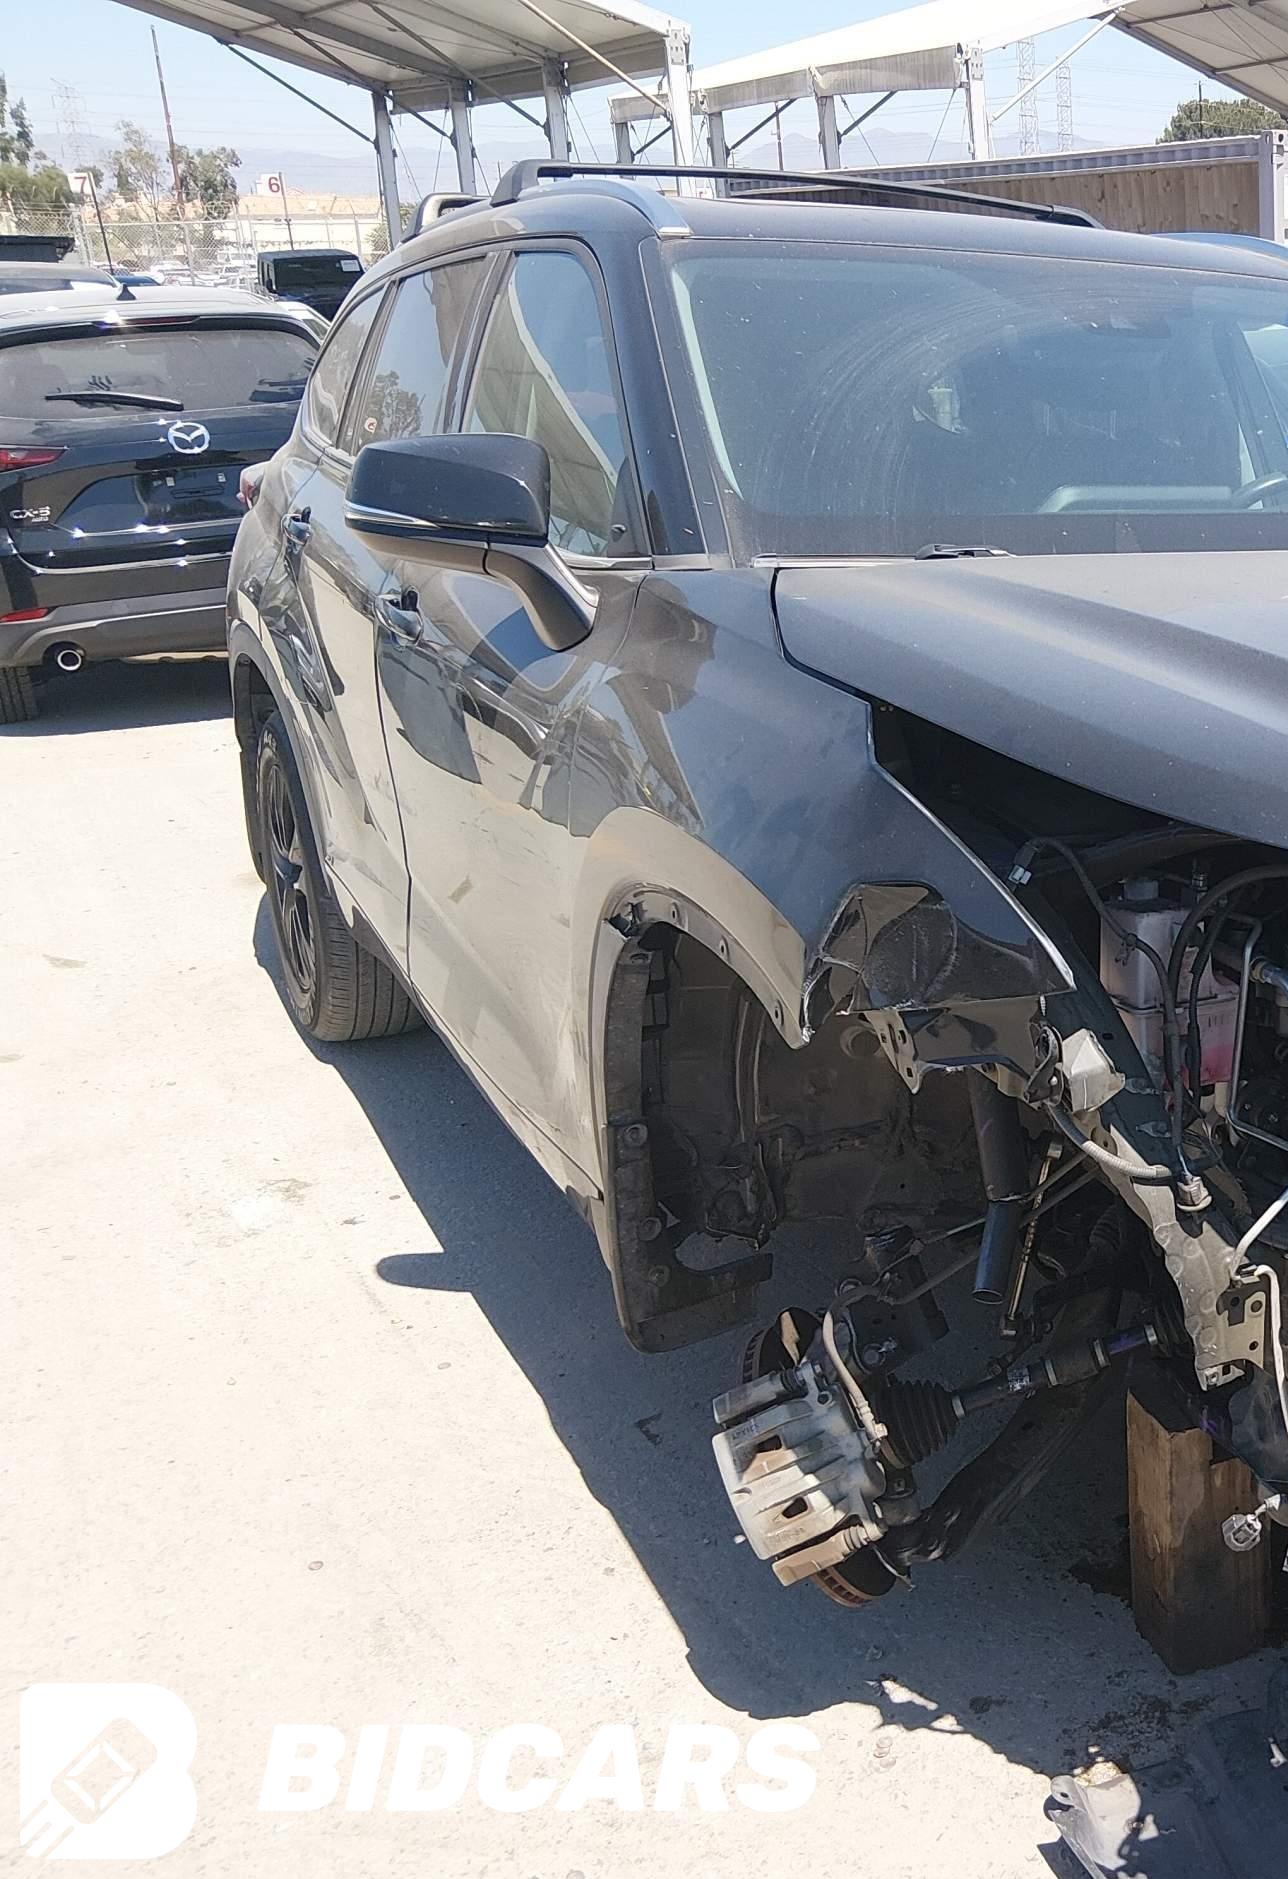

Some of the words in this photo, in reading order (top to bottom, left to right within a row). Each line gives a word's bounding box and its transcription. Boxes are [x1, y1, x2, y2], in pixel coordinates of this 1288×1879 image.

[74, 176, 87, 193] 7
[267, 176, 280, 193] 6
[10, 506, 50, 519] CX-5
